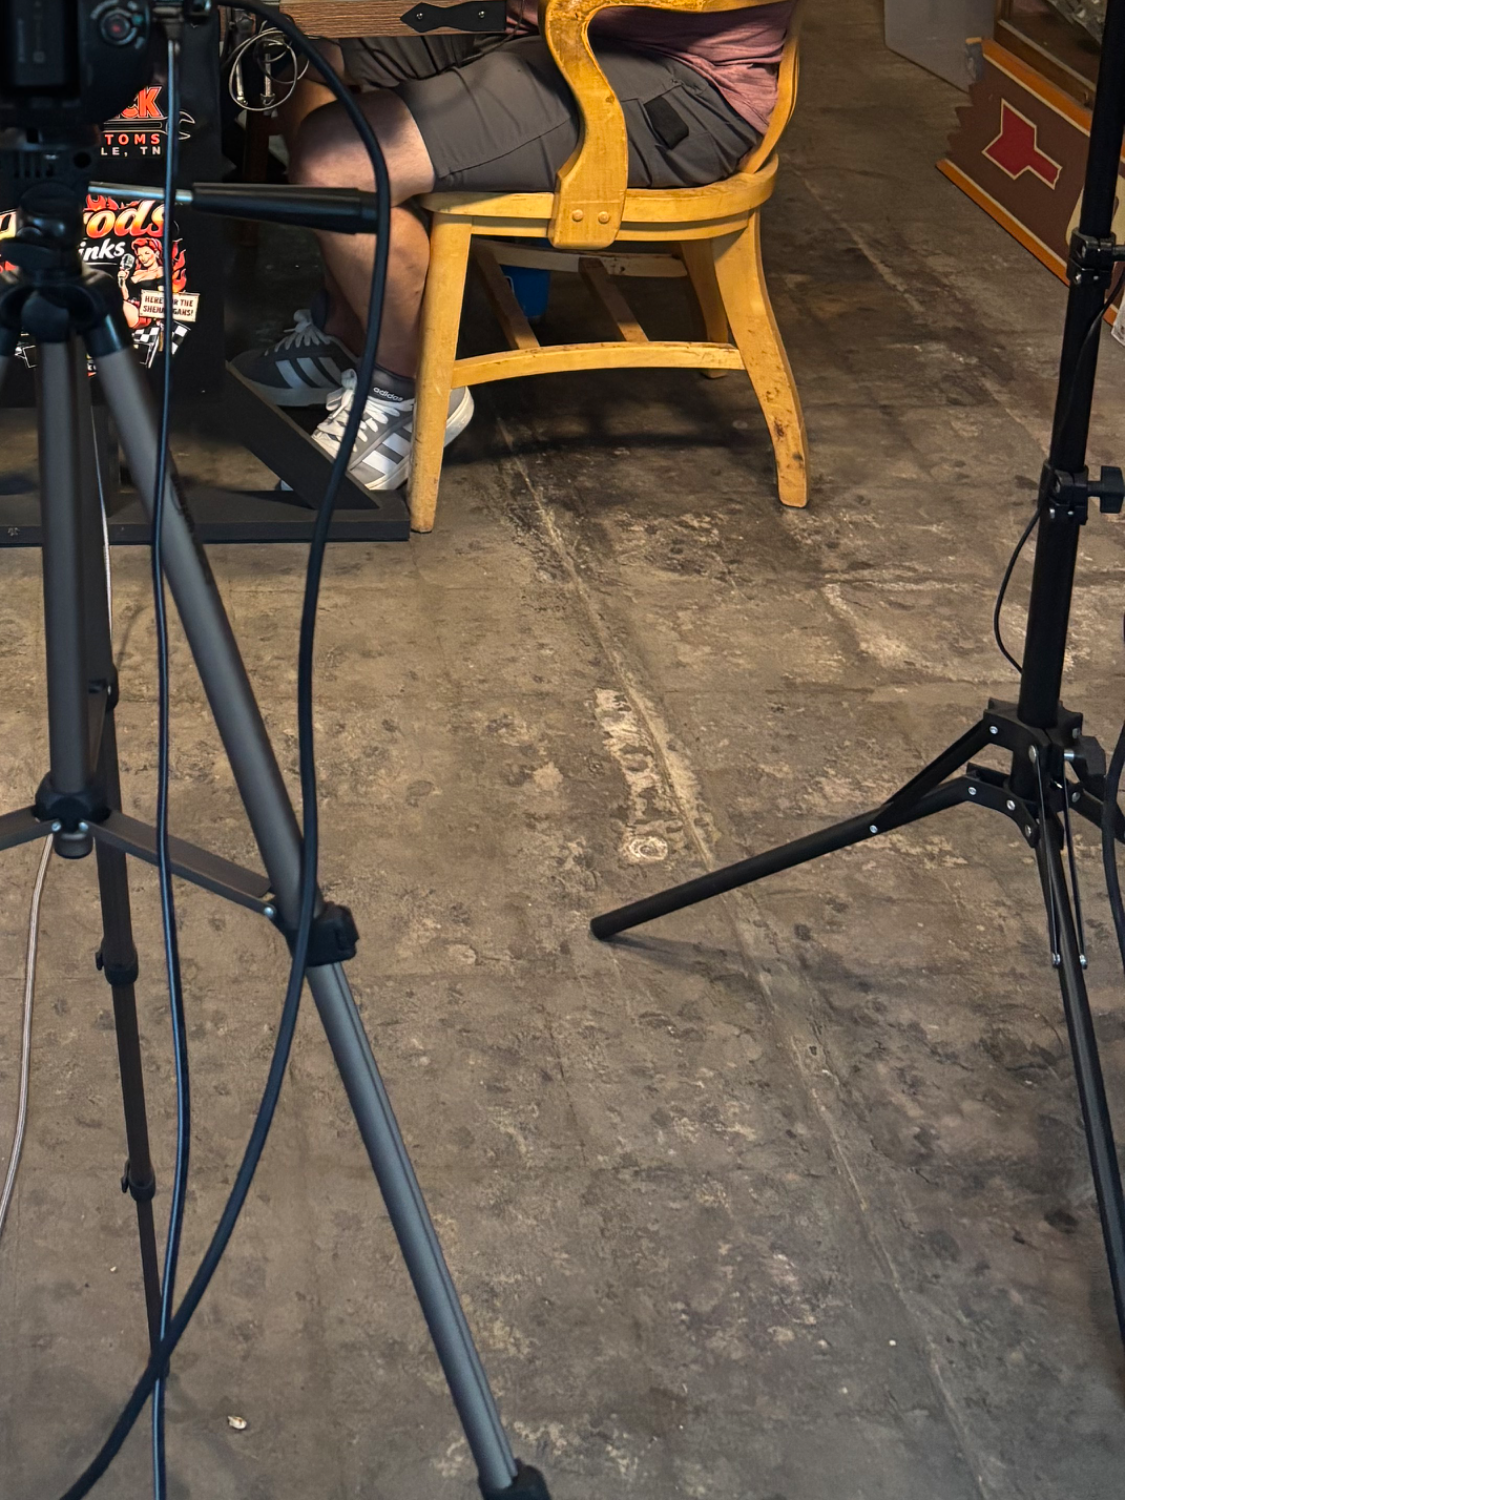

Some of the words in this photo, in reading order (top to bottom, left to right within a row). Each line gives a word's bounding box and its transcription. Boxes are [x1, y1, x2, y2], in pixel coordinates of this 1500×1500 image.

[104, 133, 161, 145] TOMS
[141, 146, 161, 155] TN
[180, 299, 194, 307] THE
[373, 387, 404, 402] adidas
